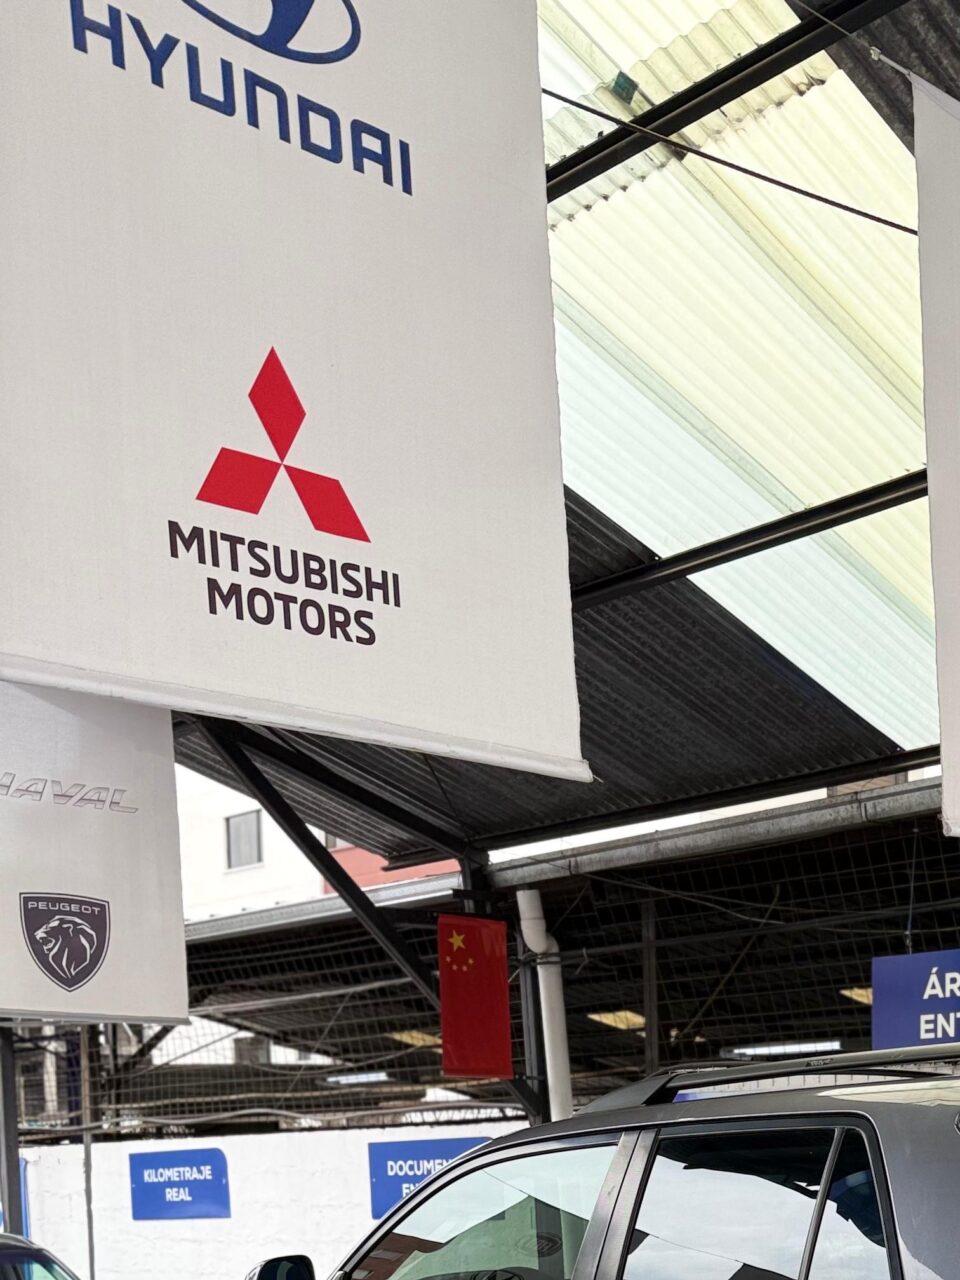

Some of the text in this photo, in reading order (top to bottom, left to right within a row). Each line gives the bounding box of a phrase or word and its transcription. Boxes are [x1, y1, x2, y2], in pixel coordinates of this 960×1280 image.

[70, 0, 413, 196] HYUNDAI
[167, 519, 401, 607] MITSUBISHI
[206, 577, 377, 646] MOTORS
[27, 901, 101, 916] PEUGEOT
[143, 1165, 213, 1183] KILOMETRAJE
[165, 1188, 192, 1202] REAL
